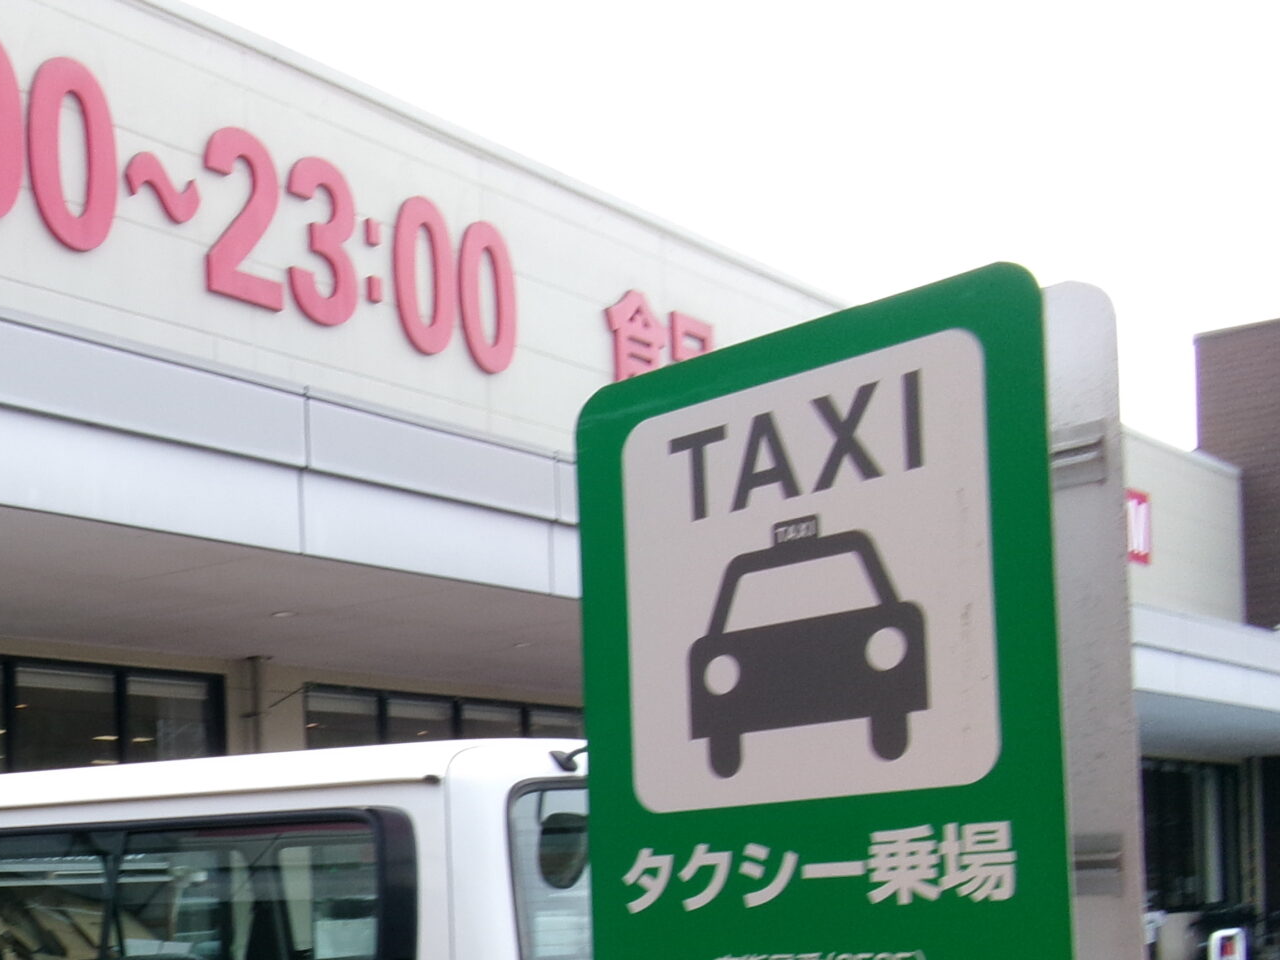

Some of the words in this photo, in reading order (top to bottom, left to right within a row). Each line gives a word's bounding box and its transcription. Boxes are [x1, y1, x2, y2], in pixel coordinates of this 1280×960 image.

[669, 368, 926, 522] TAXI
[622, 820, 1018, 914] タクシー乗場
